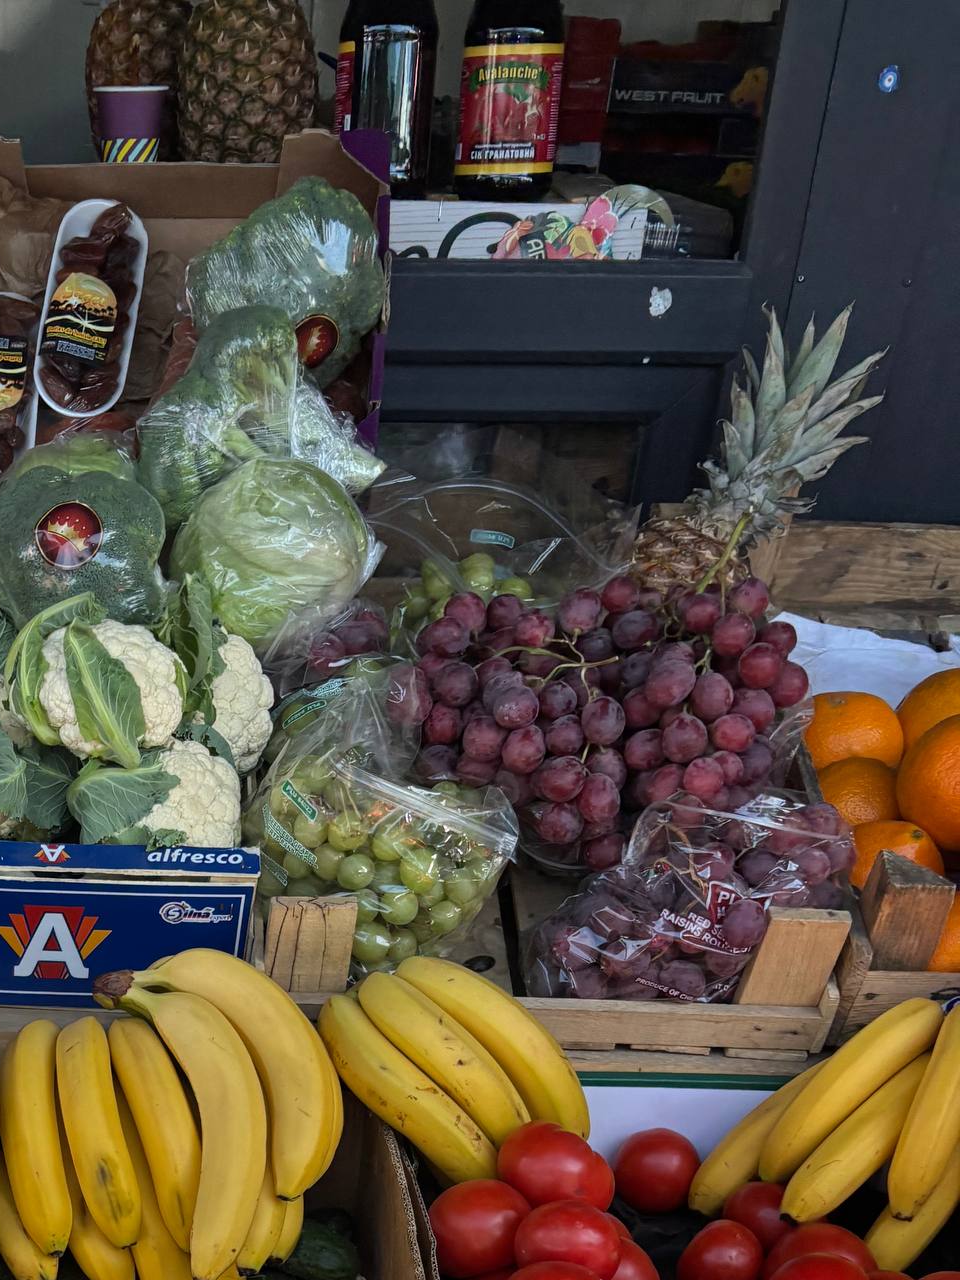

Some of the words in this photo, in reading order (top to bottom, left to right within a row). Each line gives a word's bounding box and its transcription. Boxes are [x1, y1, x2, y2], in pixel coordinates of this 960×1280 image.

[478, 65, 539, 82] Avalanche
[614, 89, 669, 102] WEST
[671, 91, 726, 104] FRUIT
[484, 147, 535, 160] ГРАНАТОВИЙ
[147, 848, 243, 865] alfresco
[659, 908, 704, 937] RAISINS
[688, 912, 711, 929] RED
[13, 911, 90, 979] A
[635, 977, 669, 993] PRODUCE
[669, 989, 680, 998] OF
